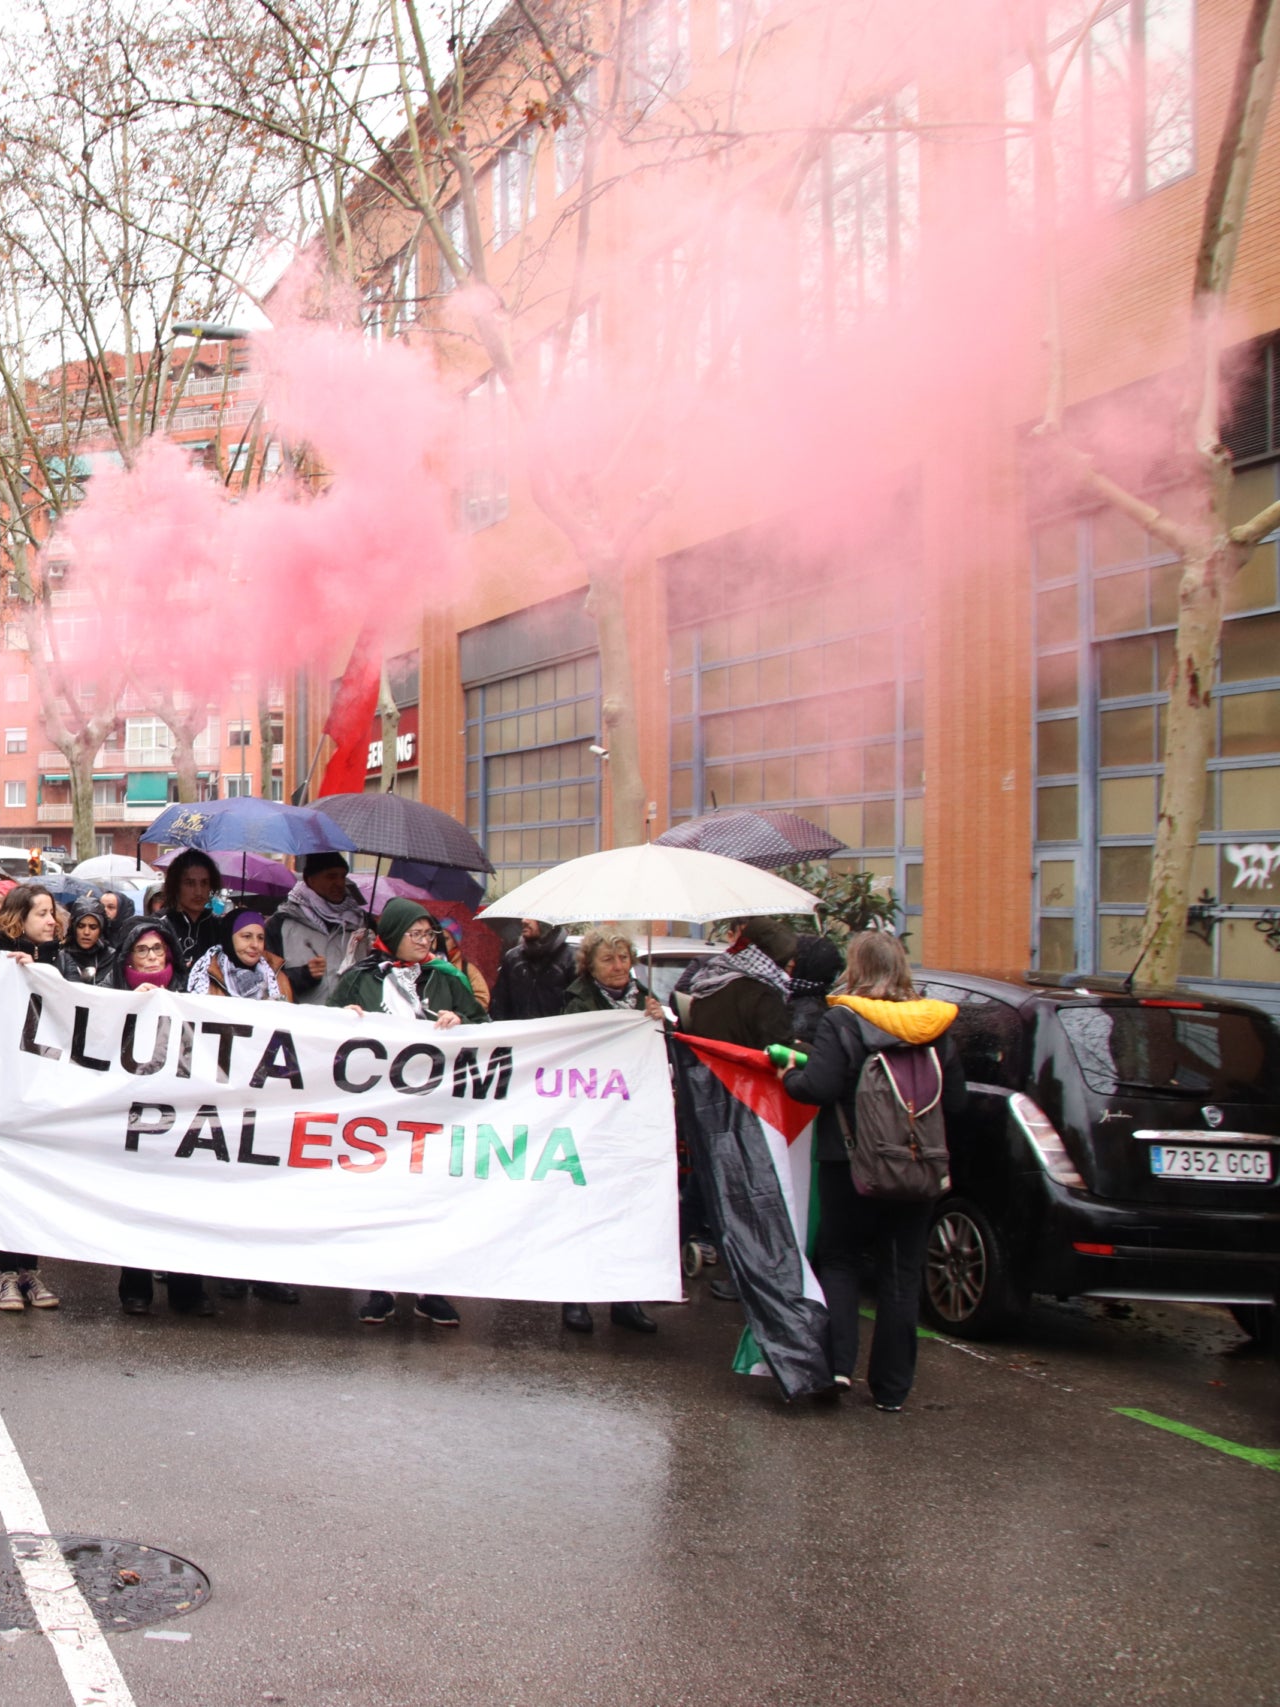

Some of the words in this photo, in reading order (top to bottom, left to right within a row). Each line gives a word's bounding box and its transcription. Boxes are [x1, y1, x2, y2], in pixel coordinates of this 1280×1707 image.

[20, 992, 304, 1090] LLUITA
[332, 1037, 513, 1100] COM
[535, 1067, 631, 1100] UNA
[124, 1101, 588, 1186] PALESTINA
[1165, 1150, 1219, 1173] 7352
[1226, 1153, 1265, 1175] GCG
